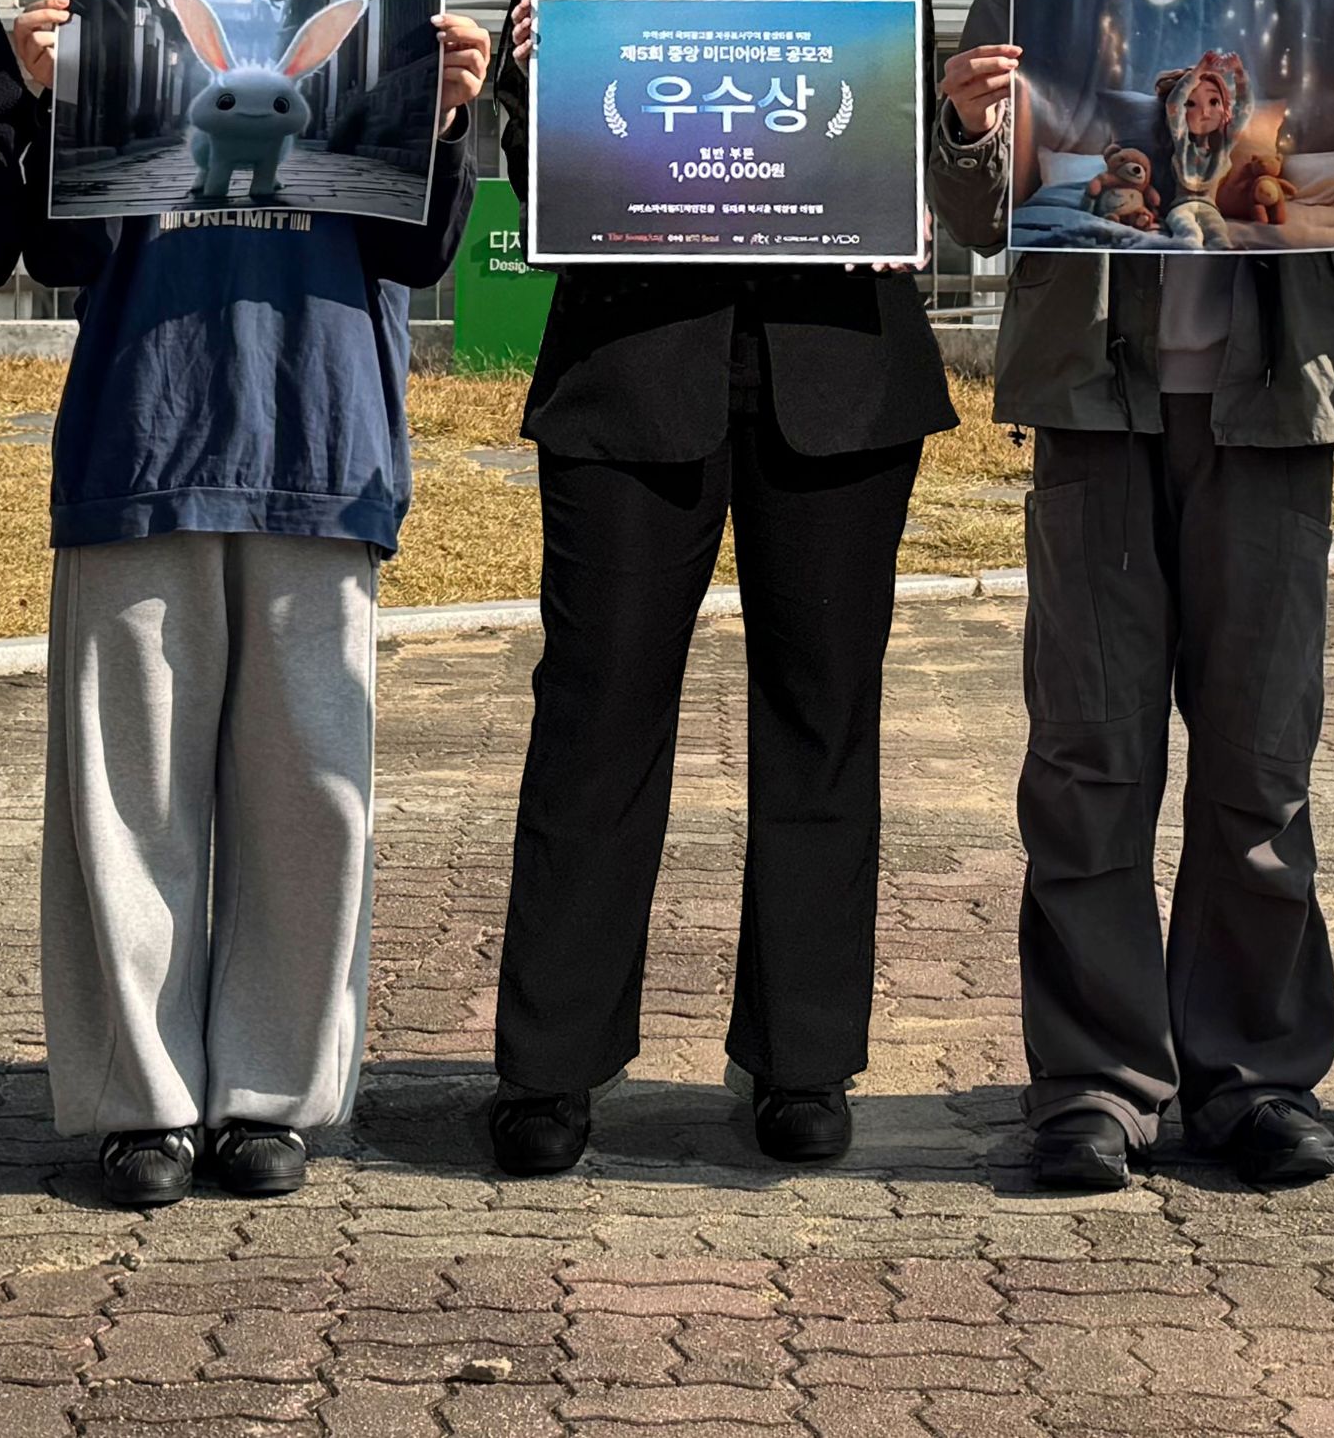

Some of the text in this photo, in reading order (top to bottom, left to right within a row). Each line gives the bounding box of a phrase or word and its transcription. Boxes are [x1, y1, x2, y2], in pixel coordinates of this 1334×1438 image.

[620, 44, 833, 63] 제5회 중앙 미디어아트 공모전
[641, 74, 815, 133] 우수상
[668, 161, 786, 183] 1,000,000원
[489, 257, 533, 274] Desig
